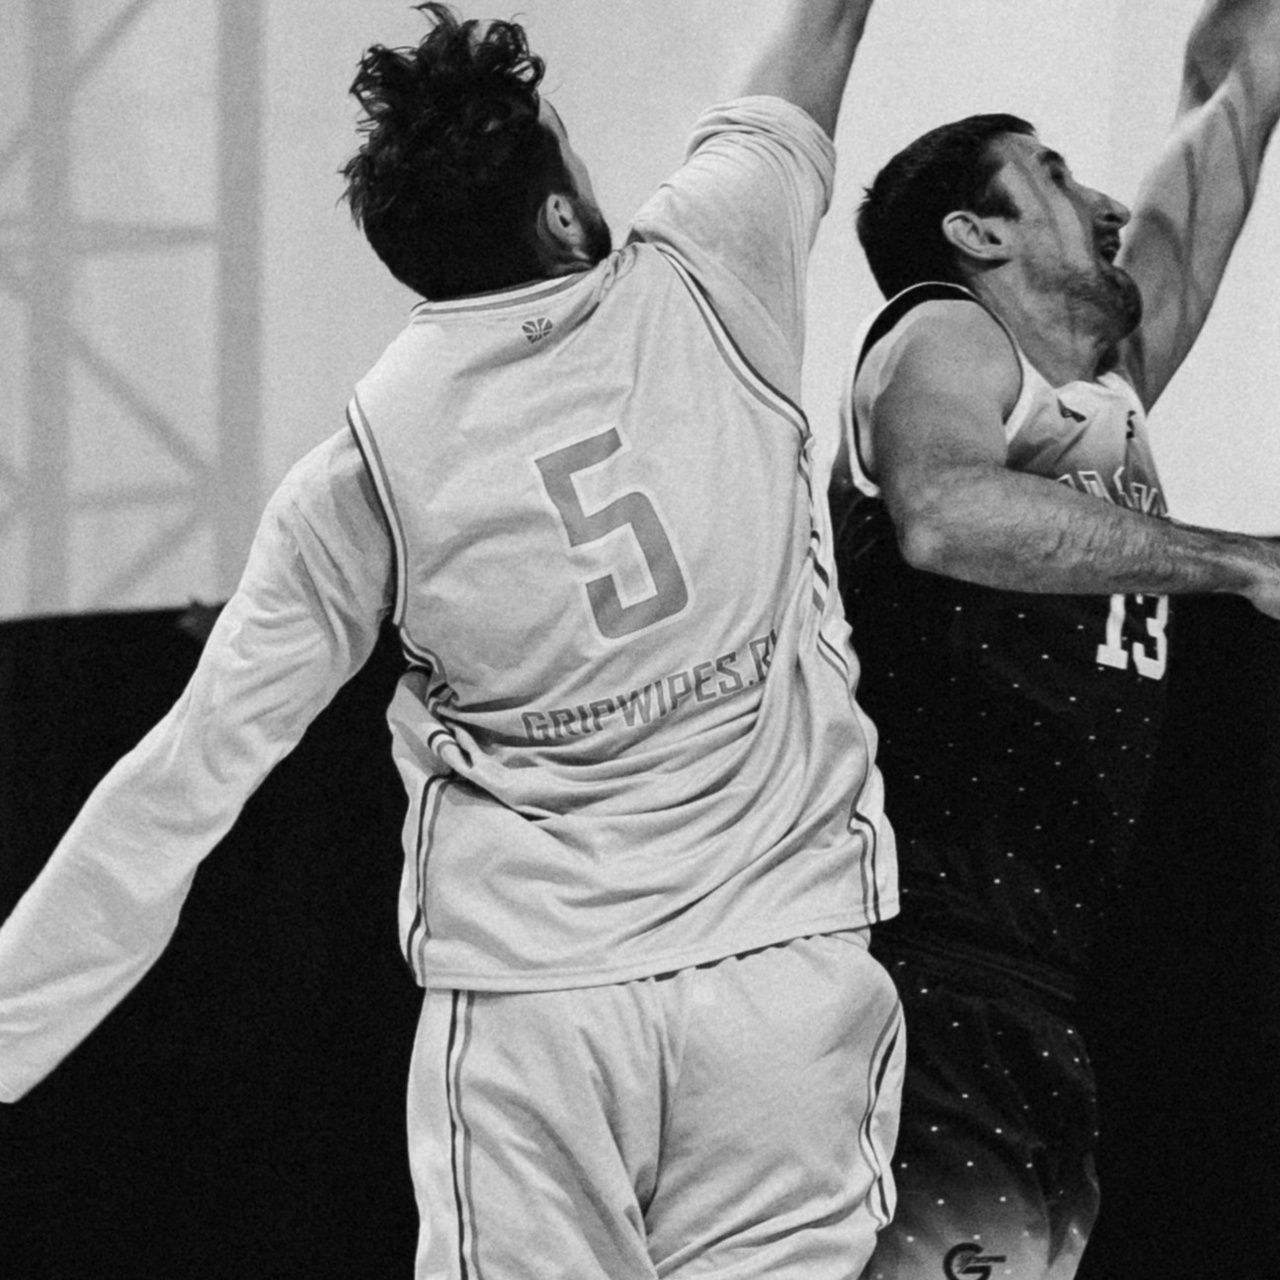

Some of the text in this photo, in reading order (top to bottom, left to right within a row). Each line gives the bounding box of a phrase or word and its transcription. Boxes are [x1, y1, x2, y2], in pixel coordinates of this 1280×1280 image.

[535, 426, 689, 640] 5
[520, 628, 778, 742] GRIPWIPES.R
[1096, 593, 1168, 681] 13
